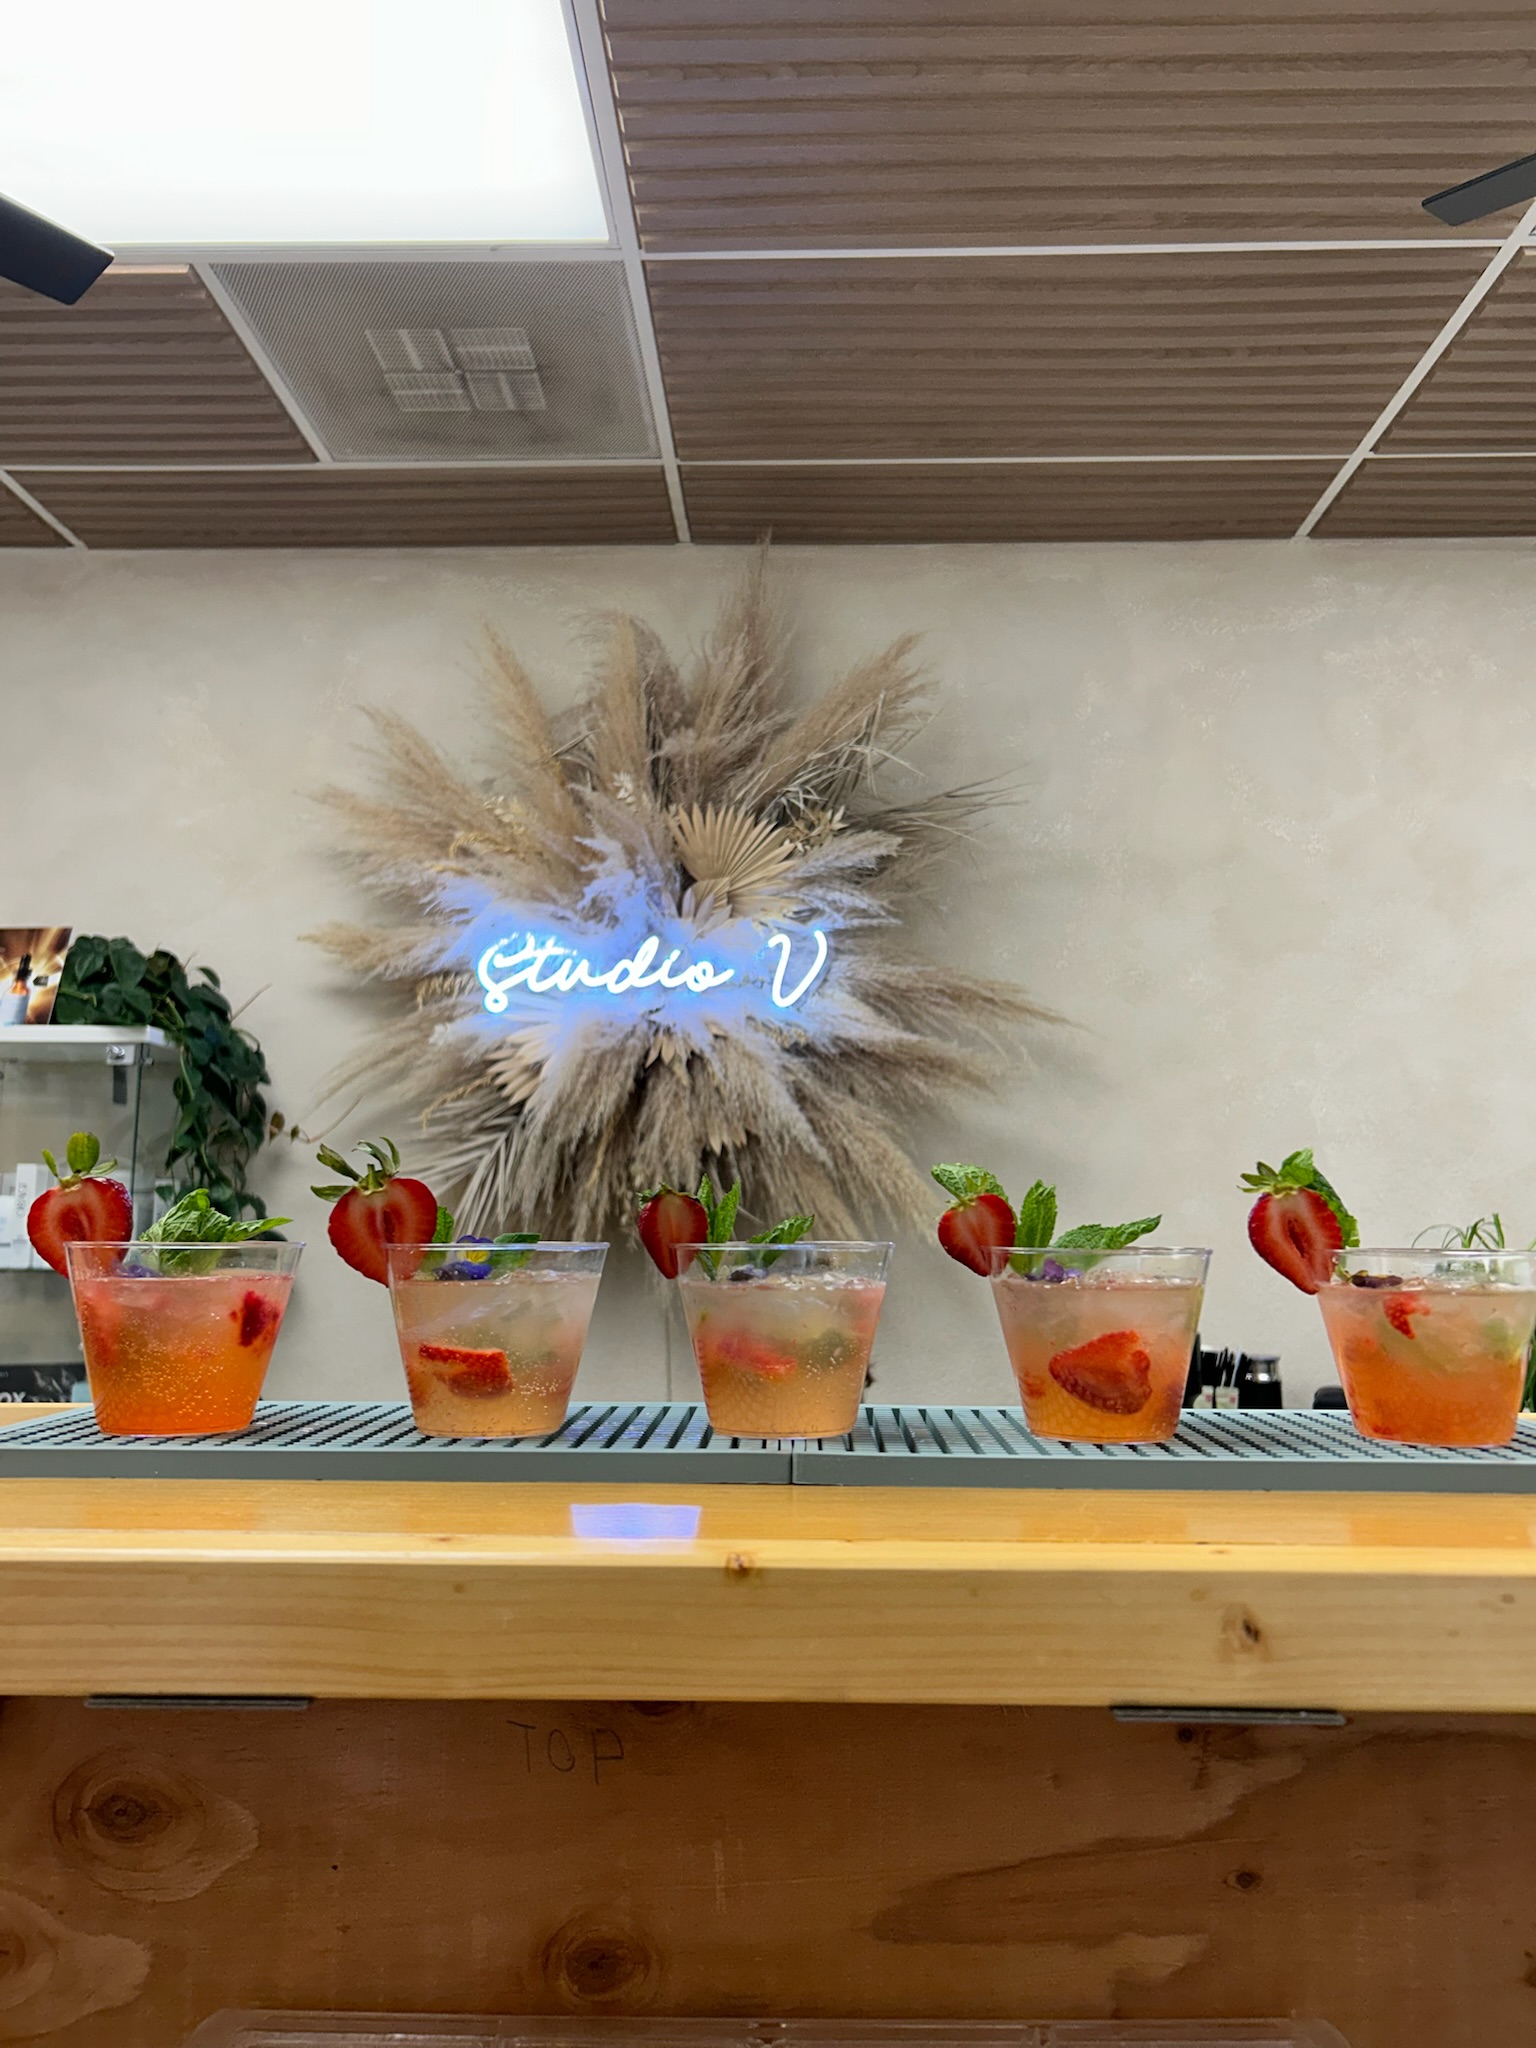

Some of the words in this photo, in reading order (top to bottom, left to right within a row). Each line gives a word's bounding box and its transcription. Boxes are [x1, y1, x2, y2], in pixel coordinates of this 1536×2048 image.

[477, 931, 734, 1013] Studio
[767, 929, 828, 1008] V
[506, 1719, 624, 1785] TOP
